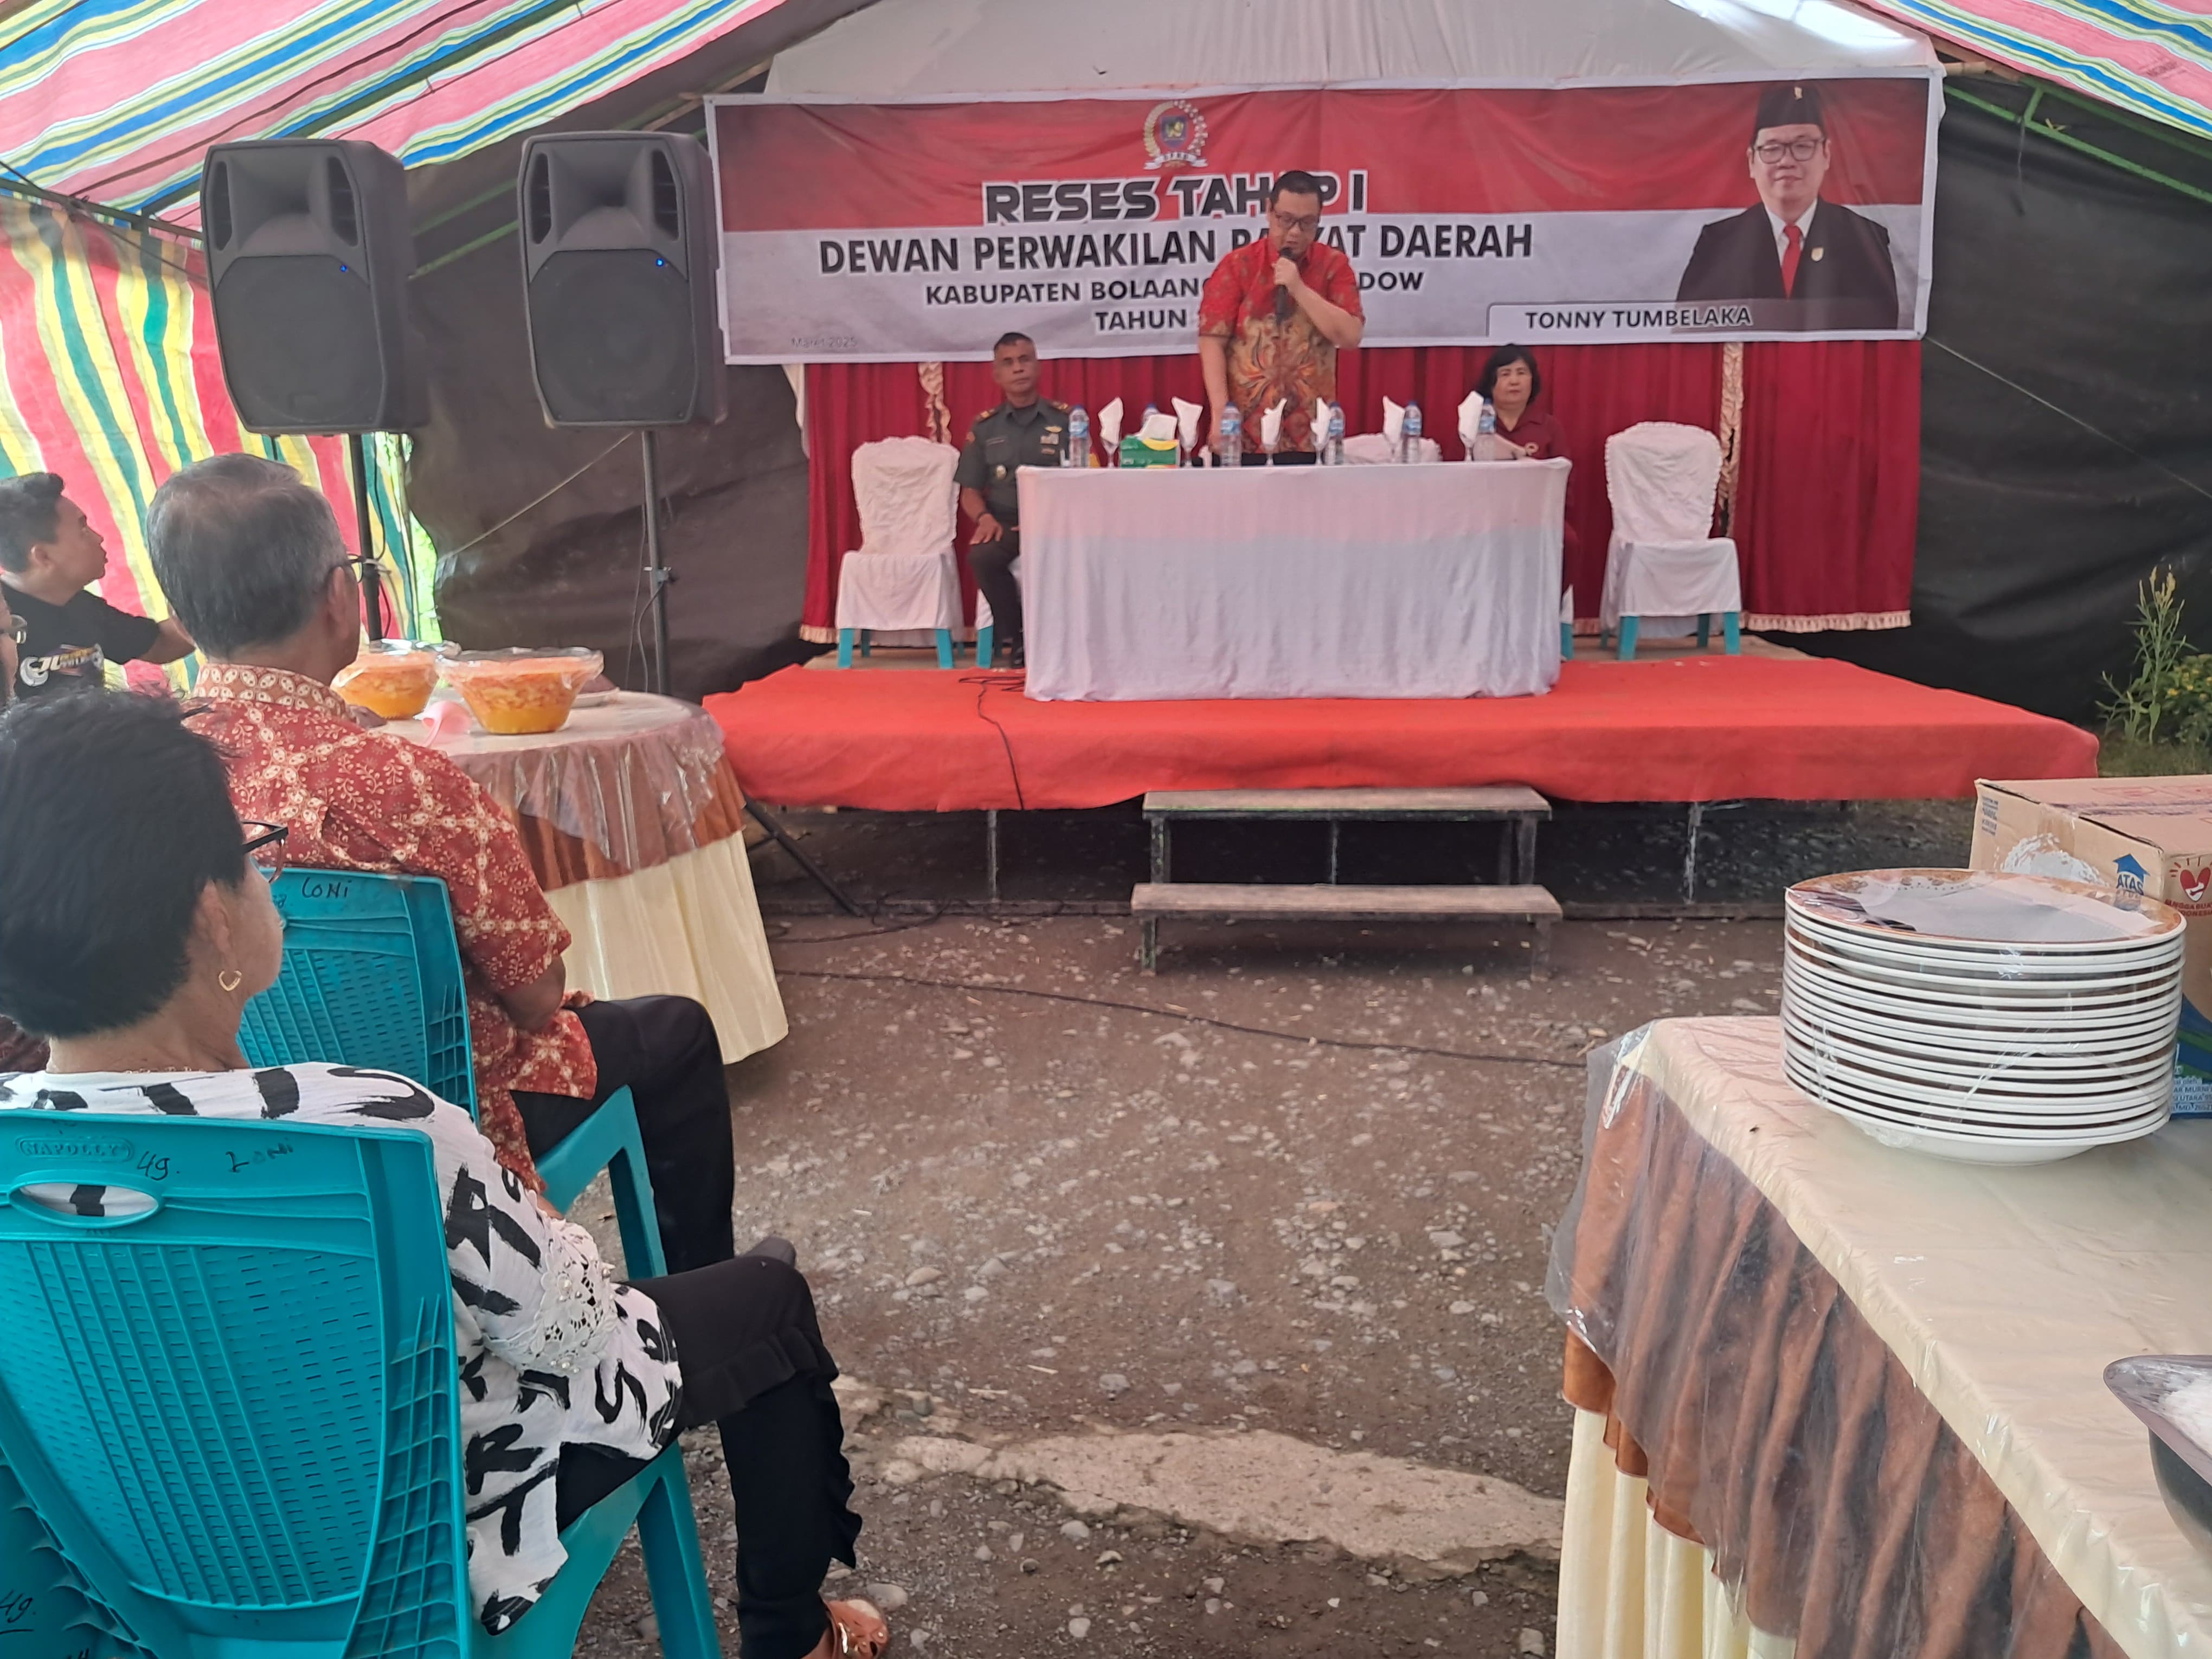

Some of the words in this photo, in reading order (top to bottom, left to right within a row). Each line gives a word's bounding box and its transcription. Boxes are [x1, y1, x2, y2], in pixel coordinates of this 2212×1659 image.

[985, 179, 1158, 224] RESES
[1172, 174, 1338, 217] TAHP
[1353, 173, 1364, 211] I
[819, 237, 959, 273] DEWAN
[975, 229, 1216, 271] PERWAKILAN
[1380, 223, 1533, 258] DAERAH
[926, 282, 1080, 305] KABUPATEN
[1091, 278, 1211, 300] BOLAAN
[1095, 309, 1186, 330] TAHUN
[1525, 310, 1606, 330] TONNY
[1612, 306, 1752, 328] TUMBELAKA
[2116, 874, 2145, 896] ATAS
